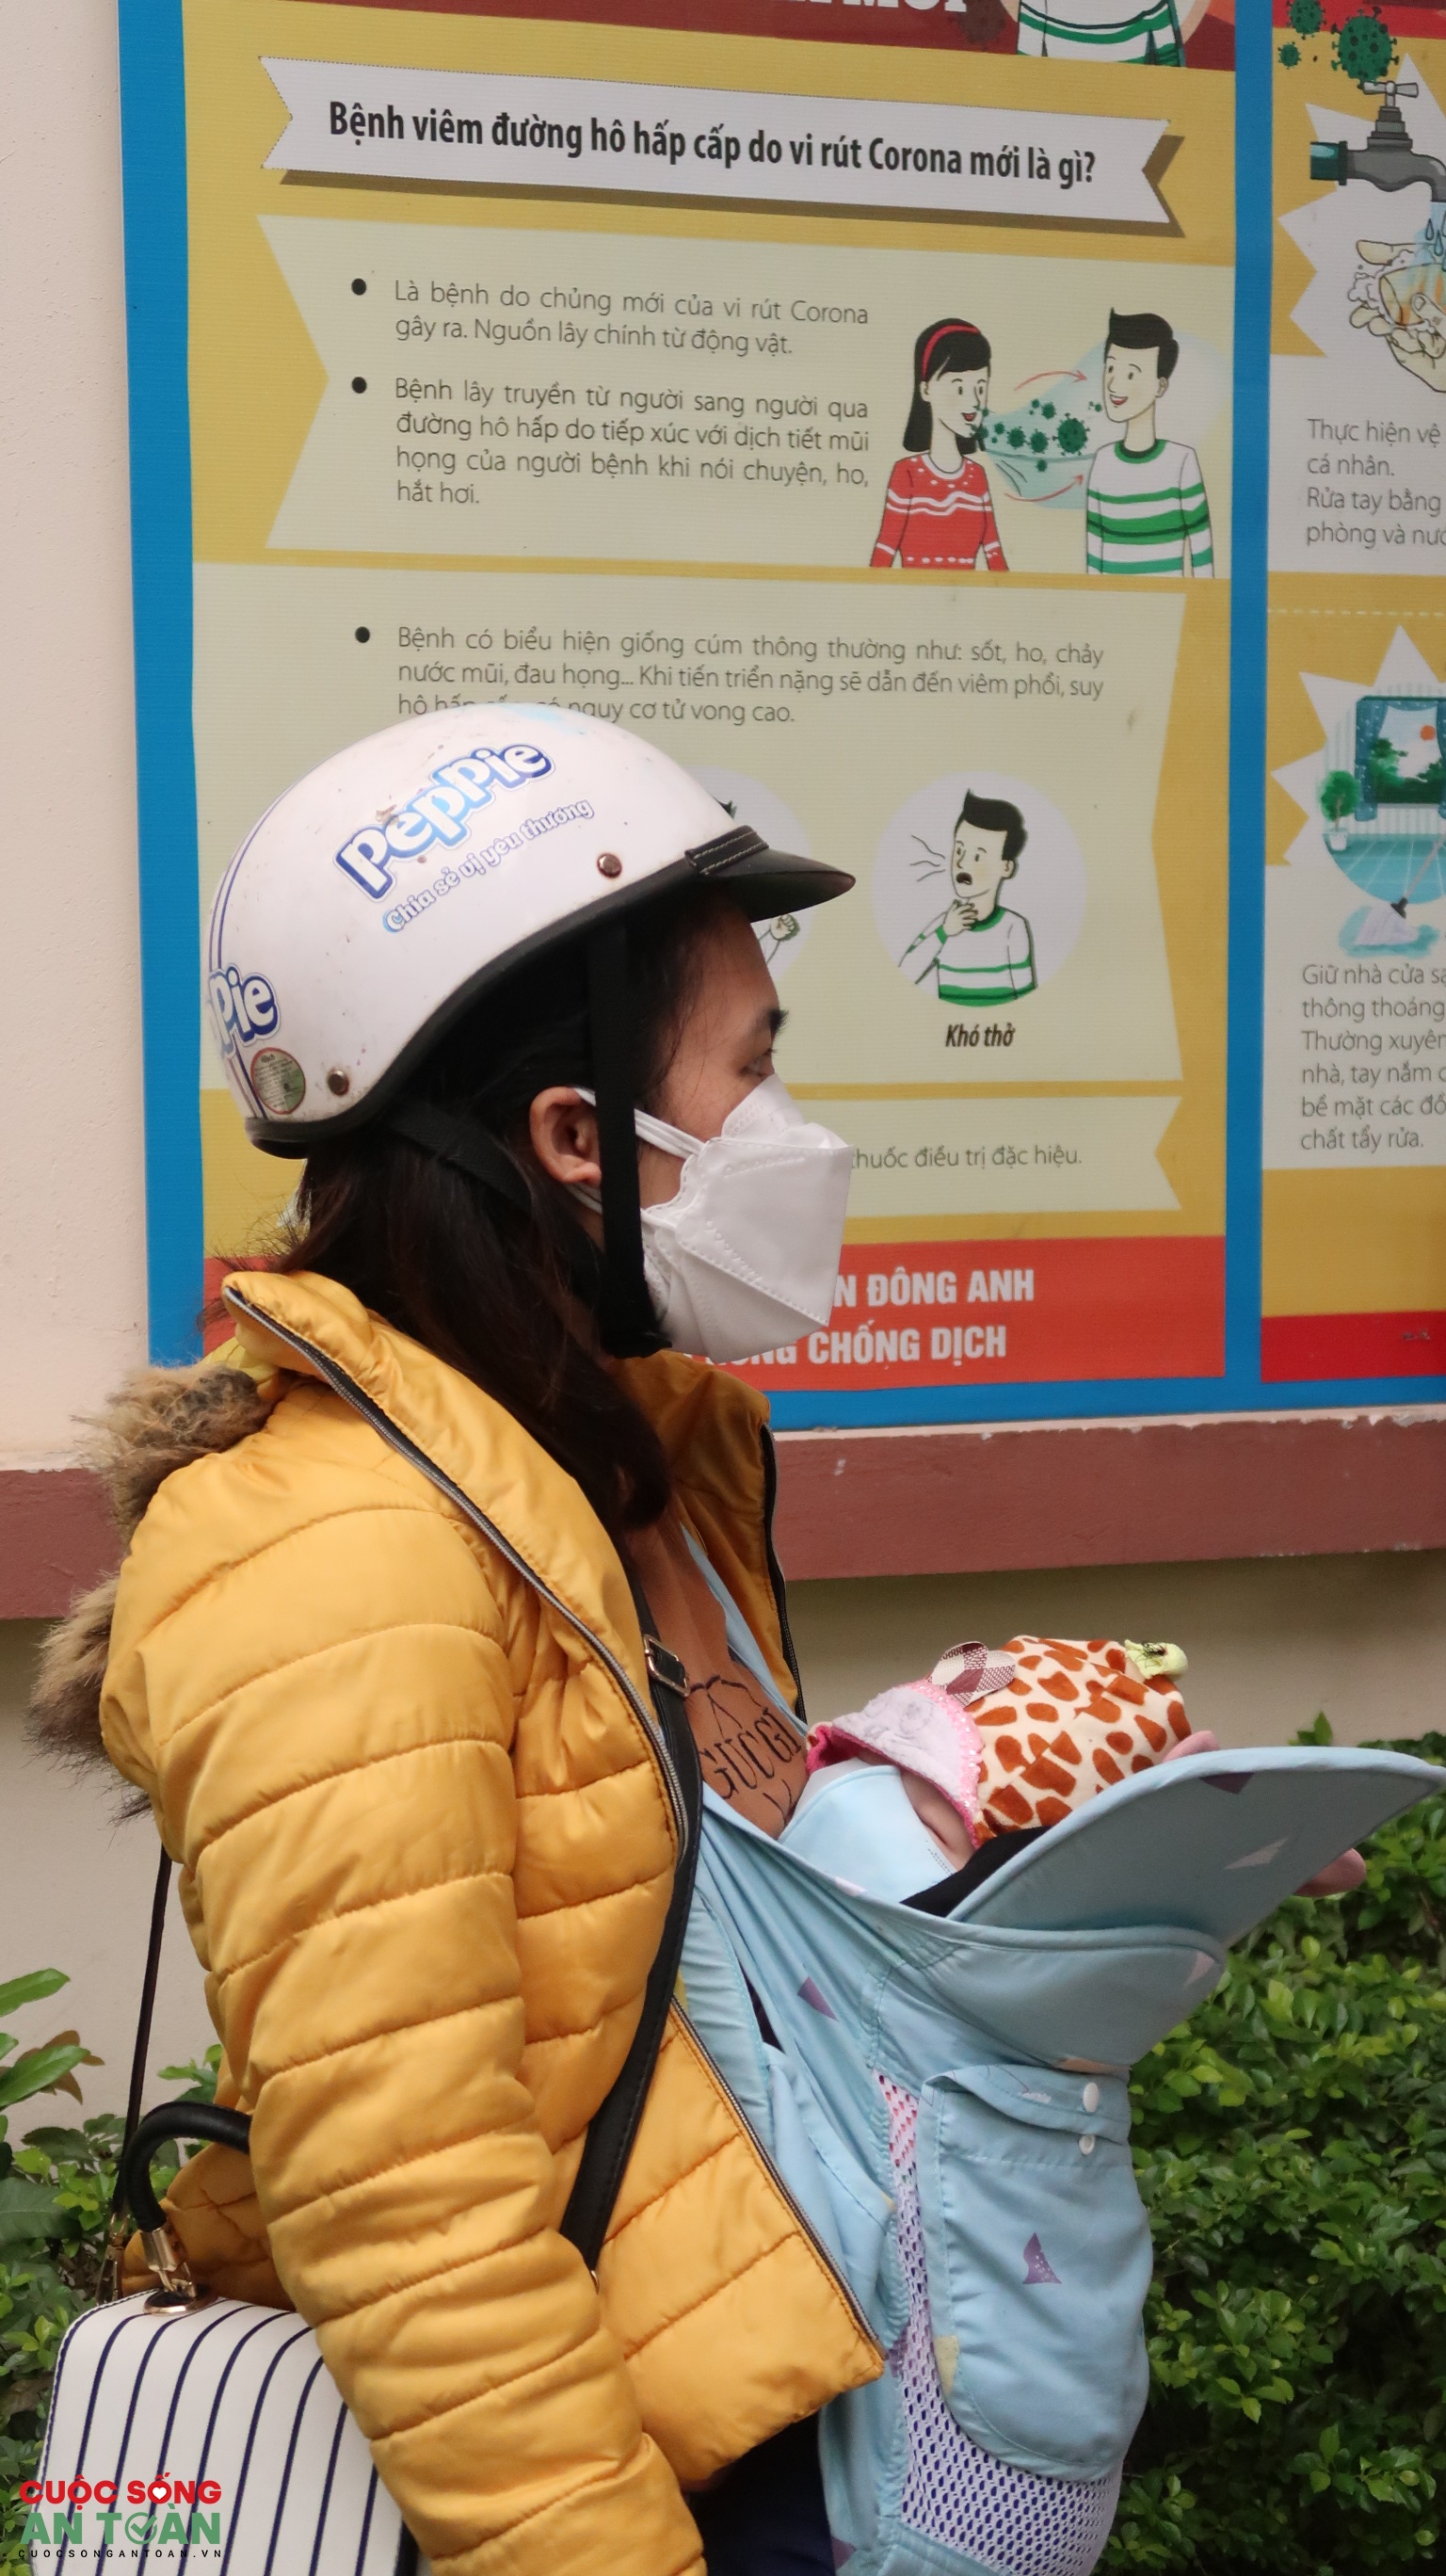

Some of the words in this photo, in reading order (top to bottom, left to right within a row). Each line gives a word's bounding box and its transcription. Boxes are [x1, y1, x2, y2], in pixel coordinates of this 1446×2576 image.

[330, 102, 404, 145] Bệnh
[412, 108, 482, 144] viêm
[492, 112, 582, 158] đường
[591, 118, 625, 153] hô
[635, 120, 685, 165] hấp
[694, 123, 740, 169] cấp
[748, 130, 781, 163] do
[790, 133, 812, 165] vi
[822, 136, 861, 169] rút
[869, 137, 961, 173] Corona
[971, 145, 1020, 177] mới
[1028, 147, 1051, 180] là
[1059, 151, 1095, 189] gì?
[395, 280, 418, 301] Là
[431, 282, 489, 307] bệnh
[500, 284, 530, 306] do
[540, 286, 611, 316] chủng
[623, 292, 664, 313] mới
[675, 294, 713, 315] của
[723, 298, 740, 317] vi
[752, 298, 781, 319] rút
[791, 300, 868, 324] Corona
[395, 314, 436, 342] gây
[443, 322, 467, 338] ra.
[475, 318, 551, 346] Nguồn
[559, 321, 588, 348] lây
[594, 323, 655, 346] chính
[663, 327, 686, 348] từ
[691, 329, 748, 357] động
[756, 332, 792, 357] vật.
[396, 378, 452, 403] Bệnh
[465, 379, 494, 408] lây
[505, 381, 575, 410] truyền
[586, 386, 610, 406] từ
[620, 389, 683, 413] người
[695, 395, 744, 418] sang
[756, 395, 817, 420] người
[828, 402, 867, 422] qua
[397, 411, 471, 441] đường
[480, 414, 509, 437] hô
[518, 414, 558, 443] hấp
[566, 418, 595, 440] do
[602, 418, 644, 445] tiếp
[651, 422, 689, 443] xúc
[696, 425, 727, 444] với
[734, 426, 779, 450] dịch
[787, 427, 822, 449] tiết
[829, 431, 868, 451] mũi
[1307, 418, 1359, 444] Thực
[1366, 420, 1410, 446] hiện
[1418, 423, 1440, 448] vệ
[397, 445, 456, 475] họng
[467, 449, 506, 471] của
[518, 451, 580, 477] người
[592, 452, 648, 478] bệnh
[659, 455, 689, 476] khi
[700, 458, 733, 479] nói
[744, 459, 827, 487] chuyện,
[837, 462, 868, 487] ho,
[1308, 453, 1330, 474] cá
[1338, 454, 1394, 475] nhân.
[398, 479, 432, 502] hắt
[441, 481, 479, 504] hơi.
[1308, 487, 1344, 508] Rửa
[1351, 491, 1382, 515] tay
[1389, 488, 1440, 518] bằng
[1307, 522, 1375, 550] phòng
[1382, 523, 1406, 544] và
[399, 627, 454, 652] Bệnh
[466, 629, 492, 649] có
[505, 626, 551, 650] biểu
[564, 630, 610, 654] hiện
[620, 630, 683, 658] giống
[695, 634, 742, 654] cúm
[752, 636, 817, 663] thông
[827, 637, 906, 665] thường
[917, 639, 961, 660] như:
[972, 639, 1006, 664] sốt,
[1017, 641, 1047, 665] ho,
[1056, 643, 1103, 668] chảy
[399, 661, 455, 683] nước
[462, 663, 508, 685] mũi,
[515, 662, 554, 684] đau
[640, 665, 672, 685] Khi
[679, 664, 718, 686] tiến
[725, 665, 773, 688] triển
[780, 670, 833, 696] nặng
[841, 671, 861, 690] sẽ
[867, 669, 906, 691] dẫn
[913, 670, 952, 692] đến
[958, 673, 1007, 693] viêm
[1015, 671, 1064, 699] phổi,
[1069, 681, 1103, 701] suy
[399, 694, 427, 715] hô
[630, 702, 656, 718] cơ
[663, 699, 685, 719] tử
[691, 705, 746, 726] vong
[752, 706, 795, 722] cao.
[1303, 964, 1339, 985] Giữ
[1343, 963, 1381, 984] nhà
[1389, 963, 1423, 984] cửa
[1302, 997, 1364, 1023] thông
[945, 1023, 979, 1047] Khó
[984, 1022, 1015, 1047] thở
[1301, 1030, 1382, 1055] Thường
[1303, 1063, 1344, 1086] nhà,
[1351, 1067, 1381, 1088] tay
[1388, 1061, 1431, 1083] nắm
[1302, 1094, 1327, 1117] bề
[1335, 1096, 1374, 1119] mặt
[1380, 1095, 1413, 1116] các
[1301, 1127, 1345, 1150] chất
[1352, 1124, 1382, 1153] tẩy
[1389, 1126, 1423, 1148] rửa.
[915, 1145, 958, 1167] điều
[966, 1147, 985, 1169] trị
[992, 1145, 1028, 1168] đặc
[1035, 1145, 1082, 1167] hiệu.
[866, 1266, 956, 1307] ĐÔNG
[967, 1269, 1034, 1302] ANH
[809, 1318, 920, 1365] CHỐNG
[931, 1326, 1005, 1366] DỊCH
